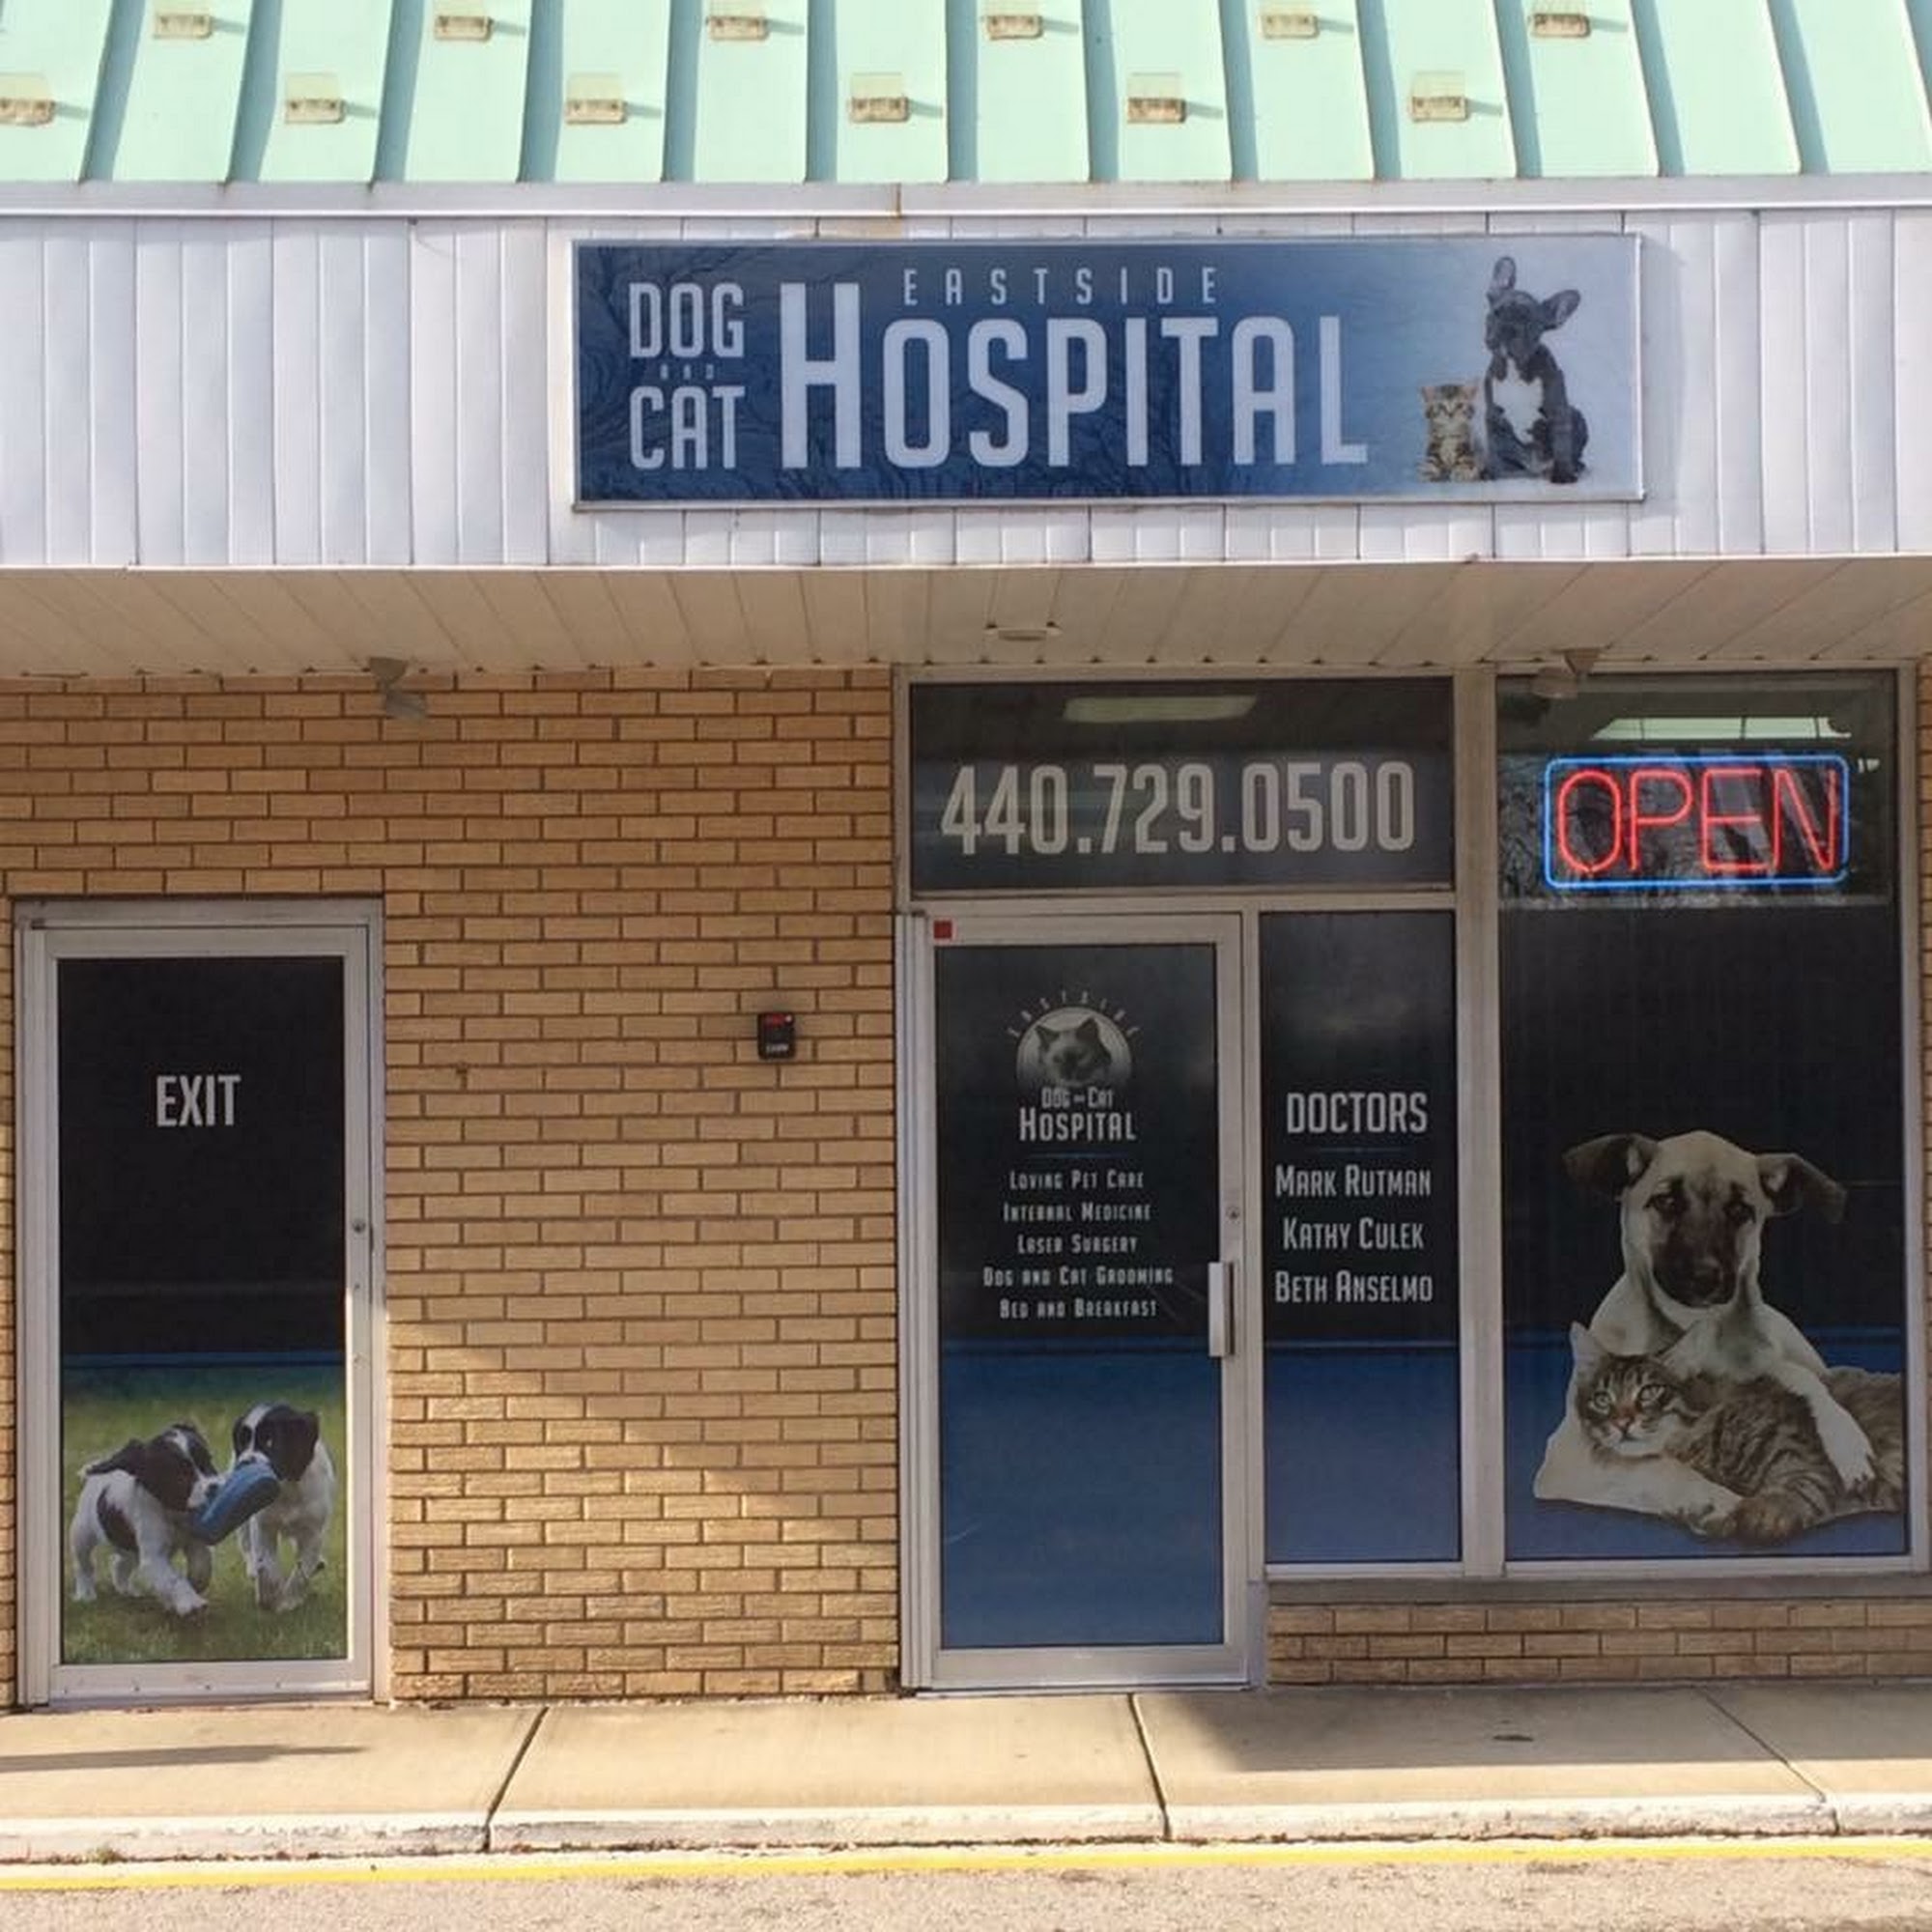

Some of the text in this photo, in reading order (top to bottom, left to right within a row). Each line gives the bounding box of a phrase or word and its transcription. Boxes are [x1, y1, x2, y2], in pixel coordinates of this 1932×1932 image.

[903, 265, 1219, 307] EASTSIDE
[629, 282, 745, 358] DOG
[780, 282, 1369, 470] HOSPITAL
[630, 385, 746, 469] CAT
[941, 760, 1415, 856] 440.729.0500
[1553, 765, 1840, 876] OPEN
[155, 1073, 242, 1128] EXIT
[1286, 1092, 1429, 1134] DOCTORS
[1019, 1107, 1137, 1142] HOSPITAL
[1071, 1169, 1098, 1190] PET
[1106, 1169, 1145, 1190] CARE
[1275, 1164, 1432, 1198] MARK RUTMAN
[1081, 1202, 1151, 1223] MEDICINE
[1071, 1233, 1138, 1255] SURGERY
[1283, 1216, 1424, 1250] KATHY CULEK
[982, 1265, 1014, 1288] DOG
[1059, 1265, 1088, 1287] CAT
[1096, 1264, 1175, 1287] GROOMING
[1274, 1269, 1434, 1303] BETH ANSELMO
[1074, 1297, 1158, 1320] BREAKFAST
